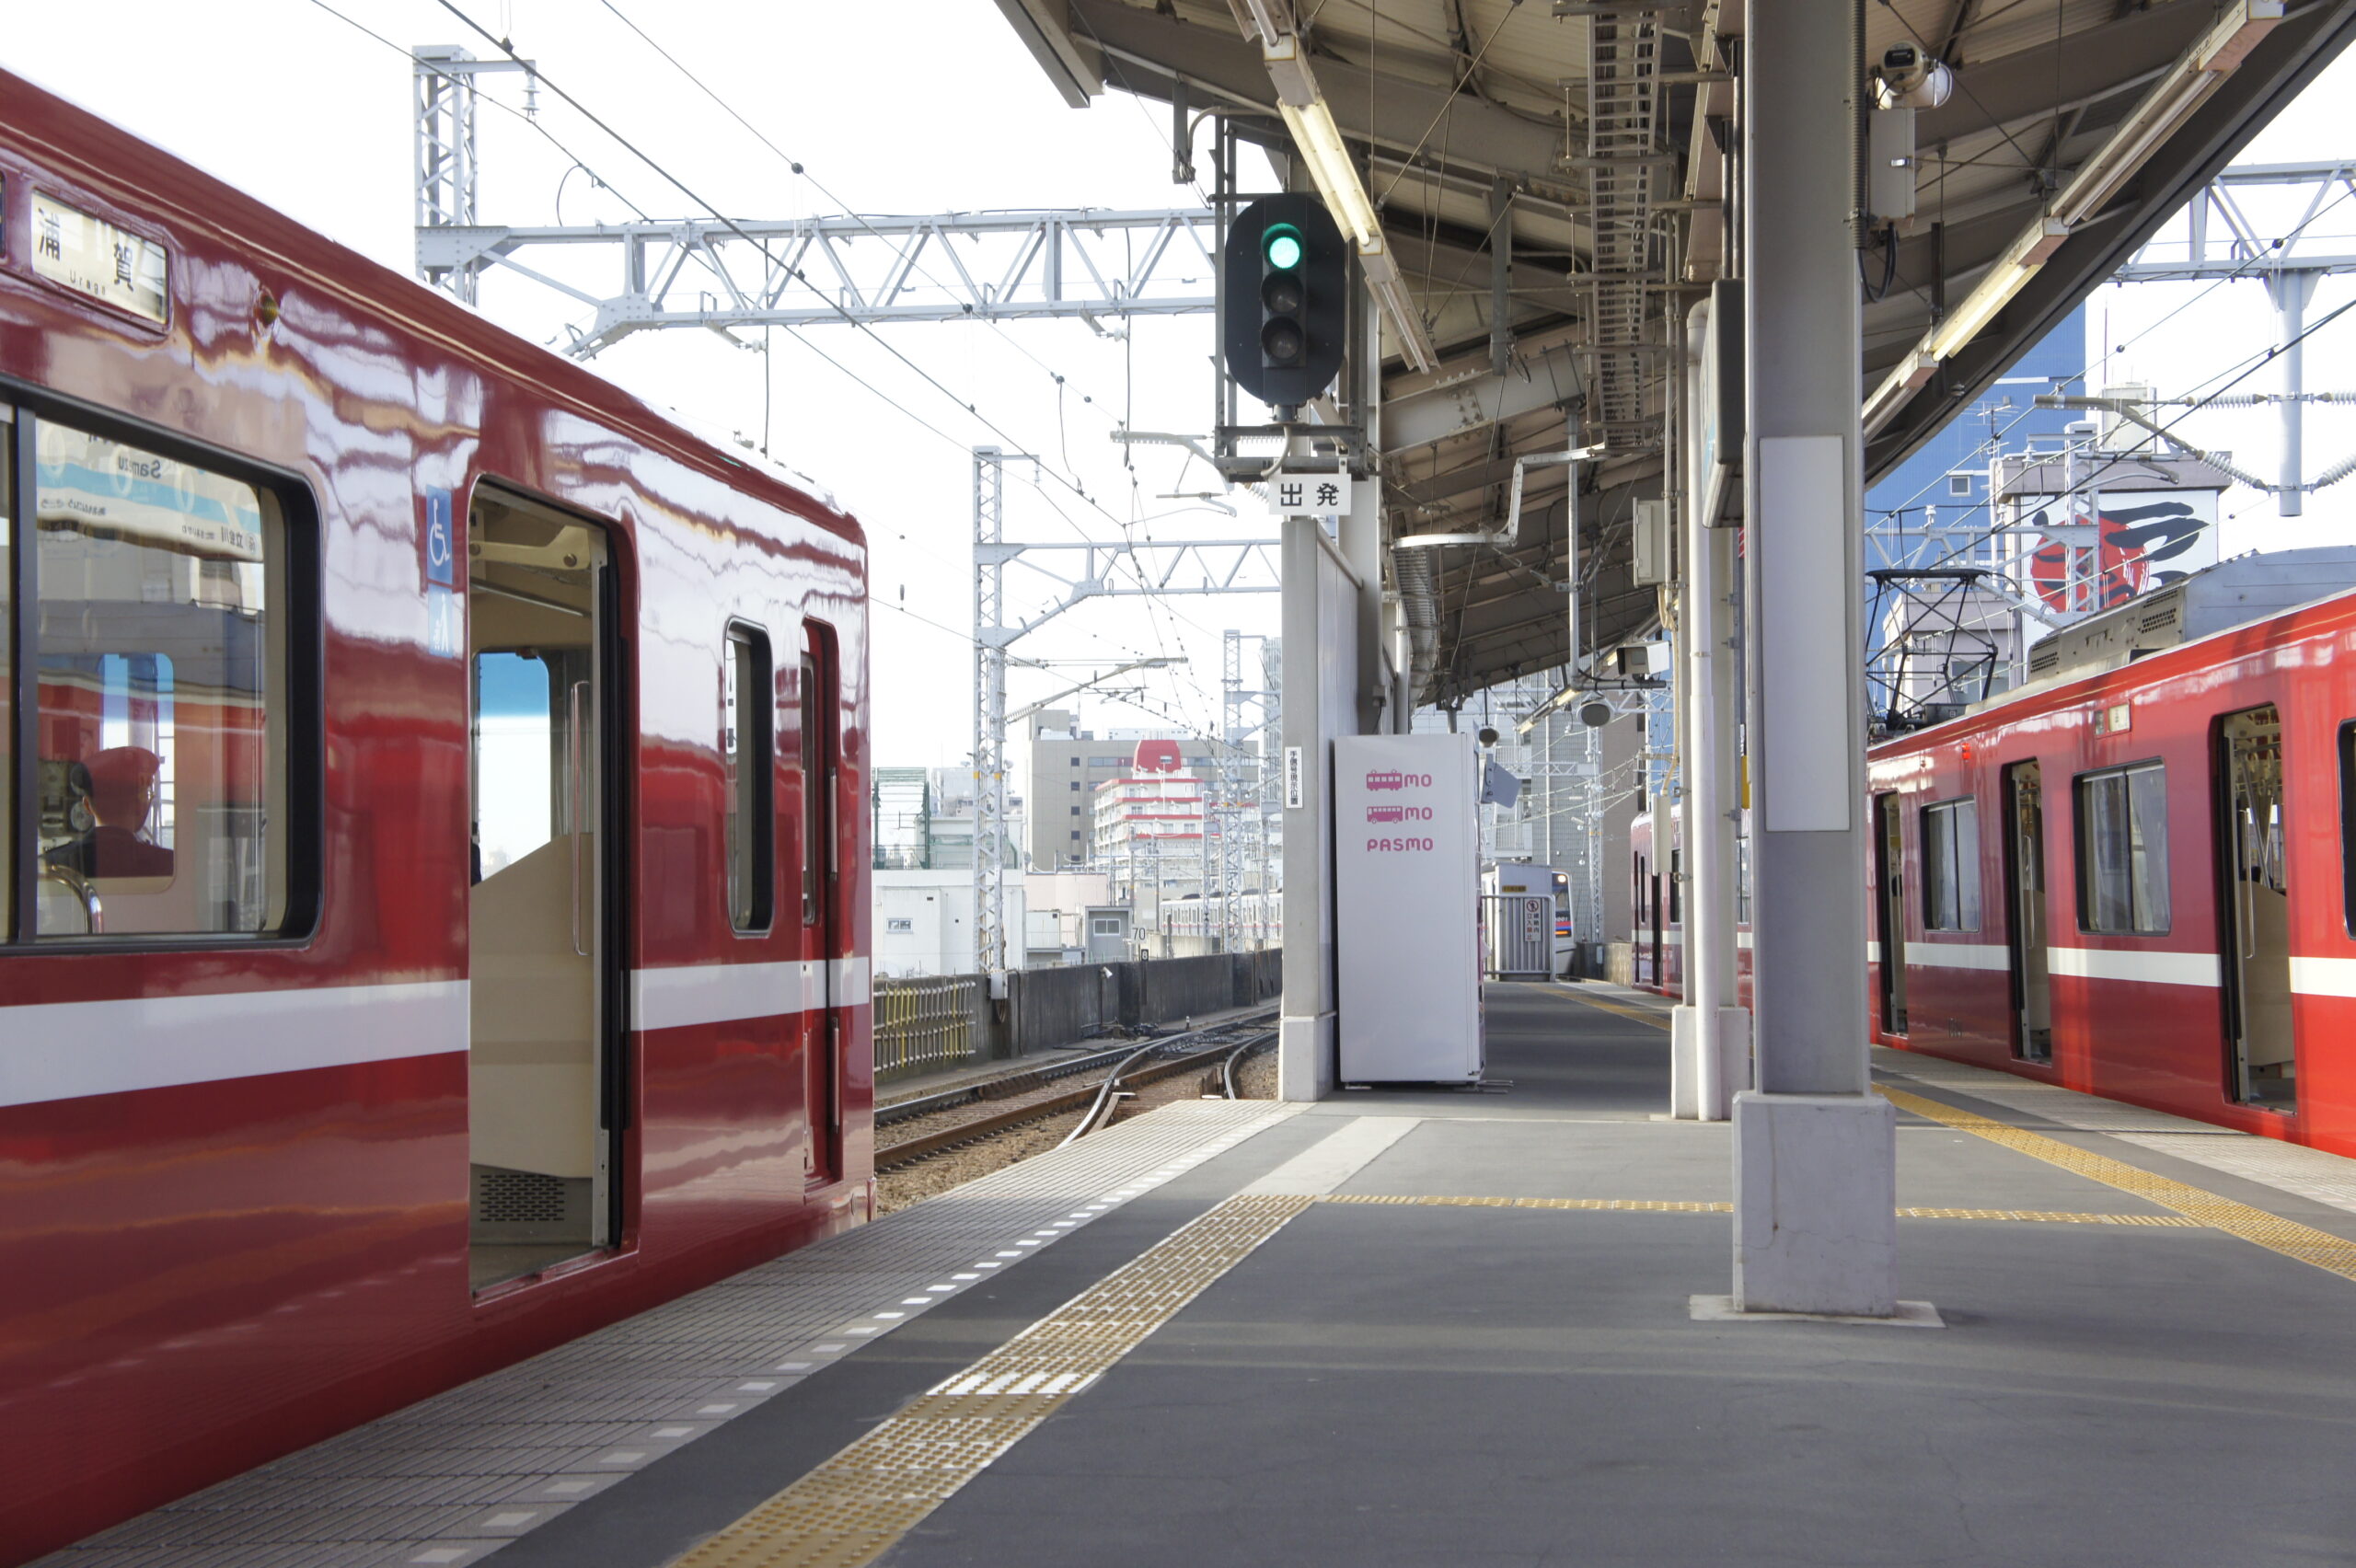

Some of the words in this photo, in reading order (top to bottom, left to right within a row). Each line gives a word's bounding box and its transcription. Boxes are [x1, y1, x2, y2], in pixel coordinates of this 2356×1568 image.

[39, 208, 134, 293] 浦賀
[1280, 483, 1340, 506] 出発
[1367, 837, 1434, 852] PASMO
[1132, 927, 1146, 940] 70
[1142, 950, 1148, 960] 8
